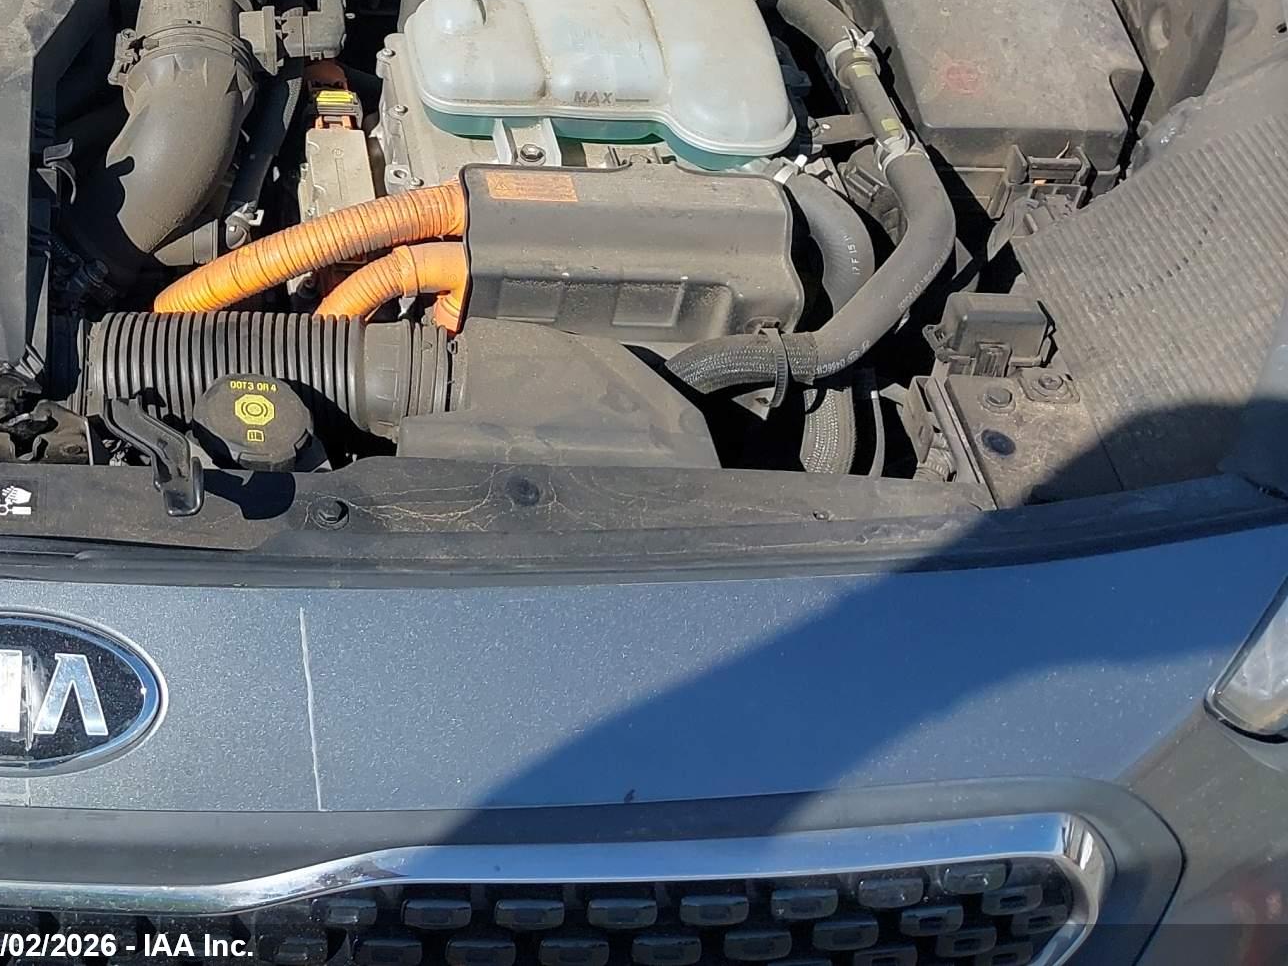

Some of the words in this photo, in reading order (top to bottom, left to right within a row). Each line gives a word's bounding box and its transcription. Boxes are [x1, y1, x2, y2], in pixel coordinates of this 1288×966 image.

[573, 90, 614, 107] MAX
[256, 382, 269, 392] OR
[270, 384, 277, 392] 4
